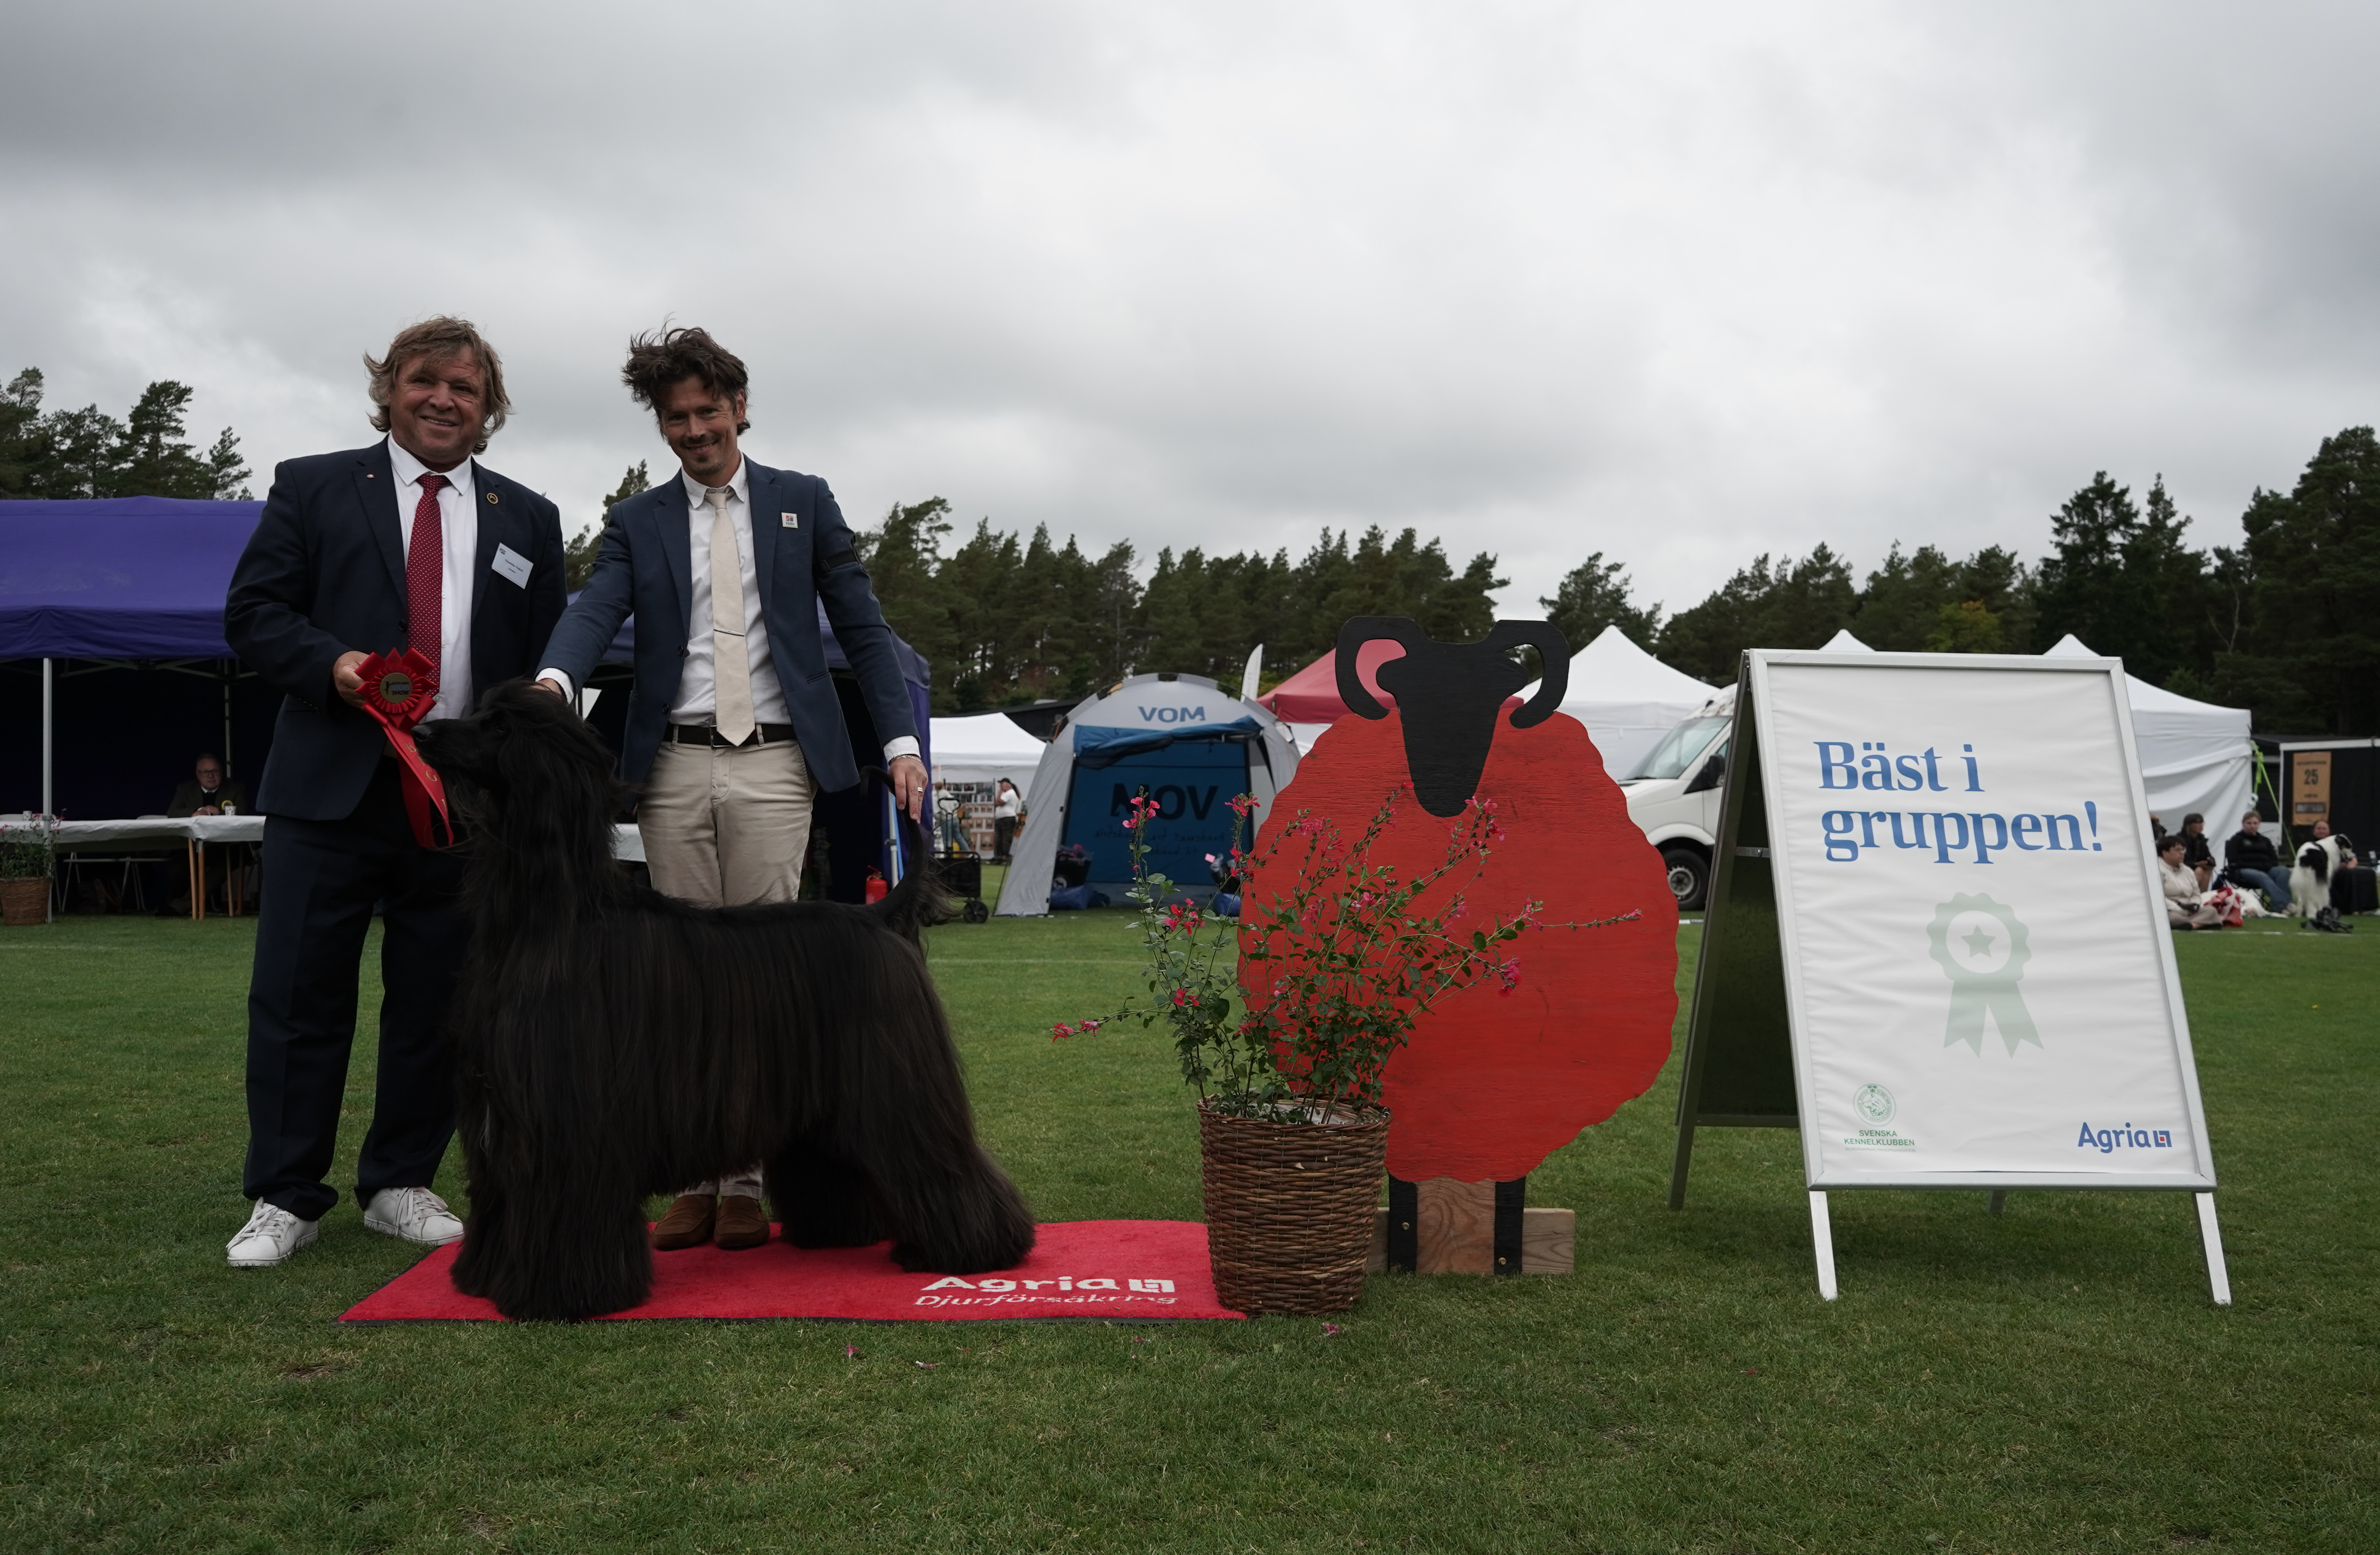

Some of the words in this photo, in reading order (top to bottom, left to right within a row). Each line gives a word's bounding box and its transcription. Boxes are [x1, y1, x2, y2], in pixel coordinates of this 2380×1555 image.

[1138, 706, 1205, 723] VOM
[404, 742, 437, 782] BIG
[1813, 742, 1949, 792] Bäst
[1960, 744, 1985, 792] i
[2304, 769, 2319, 785] 25
[1821, 801, 2102, 864] gruppen!
[2078, 1122, 2151, 1153] Agria
[920, 1276, 1120, 1292] Agria
[913, 1294, 1179, 1308] Djurförsäkring
